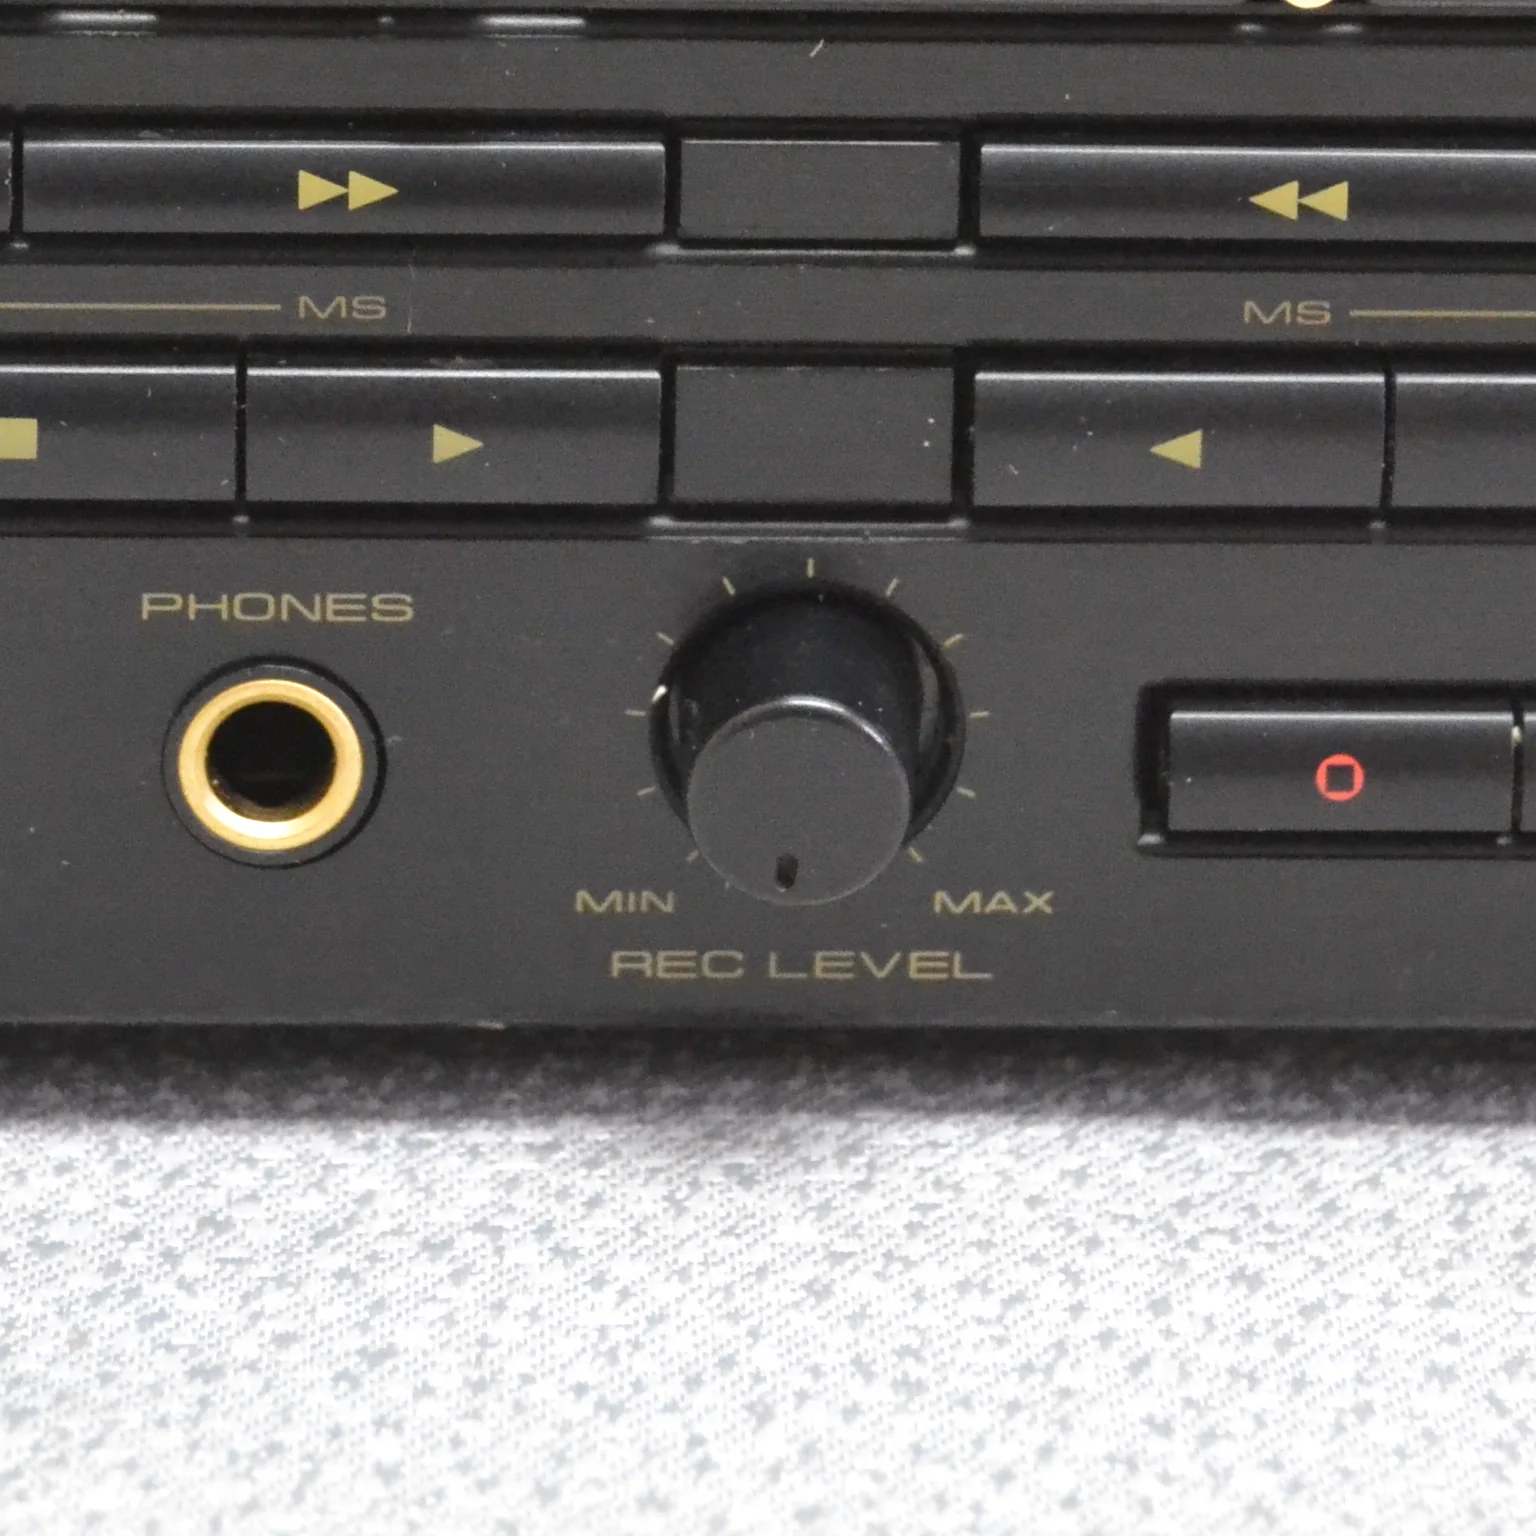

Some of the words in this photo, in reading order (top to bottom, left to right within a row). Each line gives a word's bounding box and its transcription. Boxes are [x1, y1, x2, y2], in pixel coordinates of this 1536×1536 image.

[299, 295, 386, 320] MS
[1244, 301, 1331, 325] MS
[142, 593, 413, 622] PHONES
[575, 890, 674, 912] MIN
[934, 891, 1052, 913] MAX
[612, 951, 743, 978] REC
[769, 951, 992, 979] LEVEL
